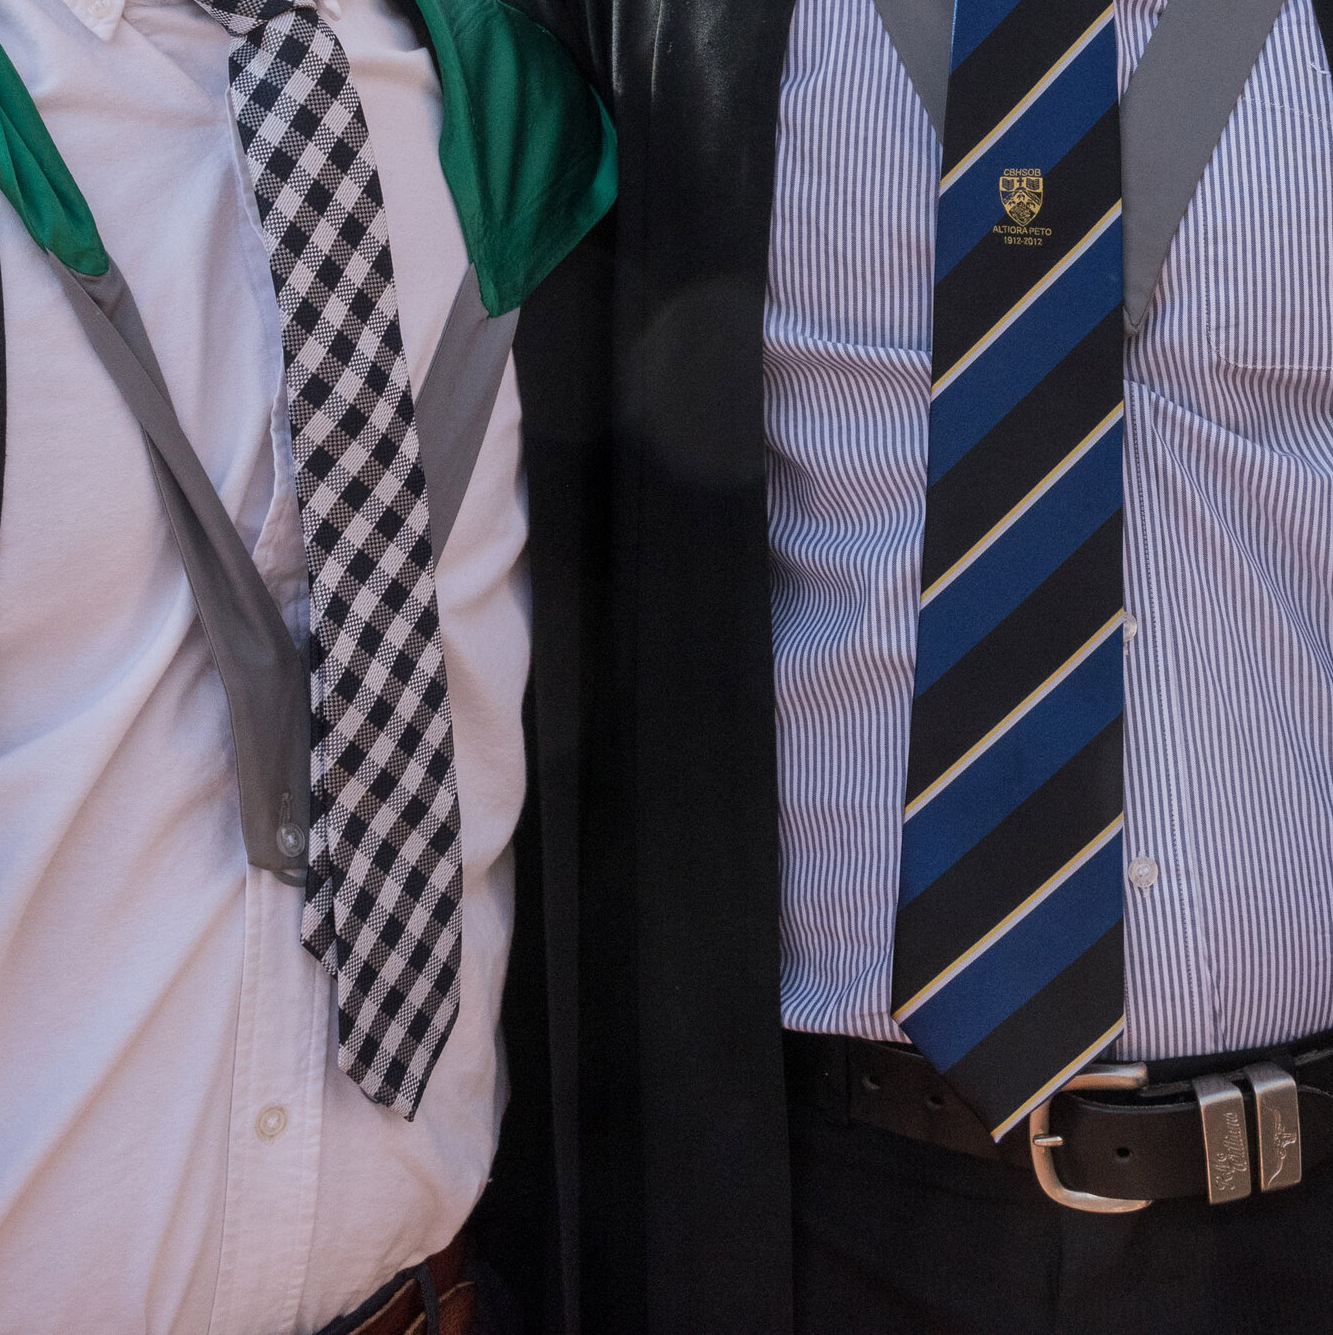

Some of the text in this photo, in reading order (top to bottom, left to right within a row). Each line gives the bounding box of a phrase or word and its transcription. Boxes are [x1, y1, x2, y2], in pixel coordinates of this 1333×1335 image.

[1003, 168, 1042, 177] CBHSOB
[992, 225, 1052, 236] ALTIORA PETO
[1003, 236, 1043, 246] 1912-2012
